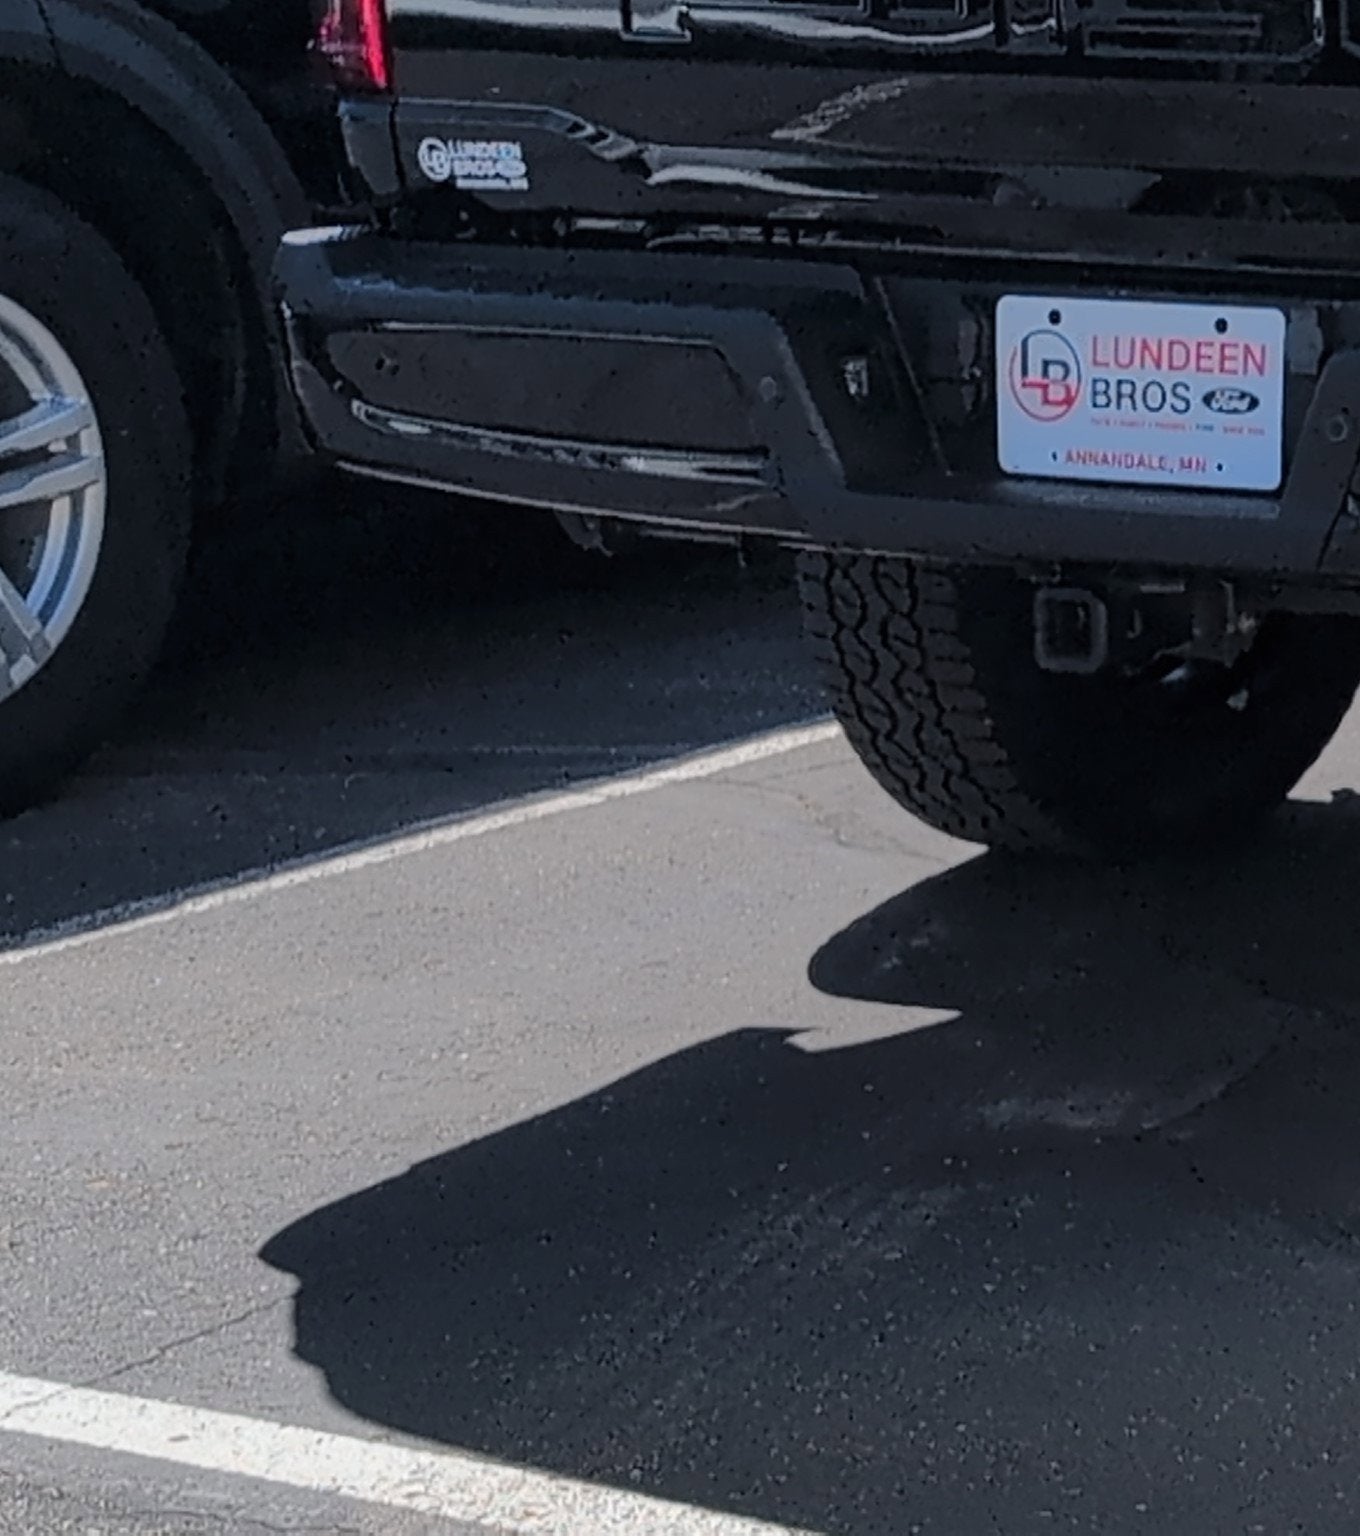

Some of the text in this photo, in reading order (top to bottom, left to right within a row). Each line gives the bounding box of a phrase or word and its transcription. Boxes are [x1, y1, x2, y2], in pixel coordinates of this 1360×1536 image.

[1092, 335, 1266, 376] LUNDEEN
[1091, 378, 1192, 414] BROS
[1065, 449, 1207, 474] ANNANDALE, MN
